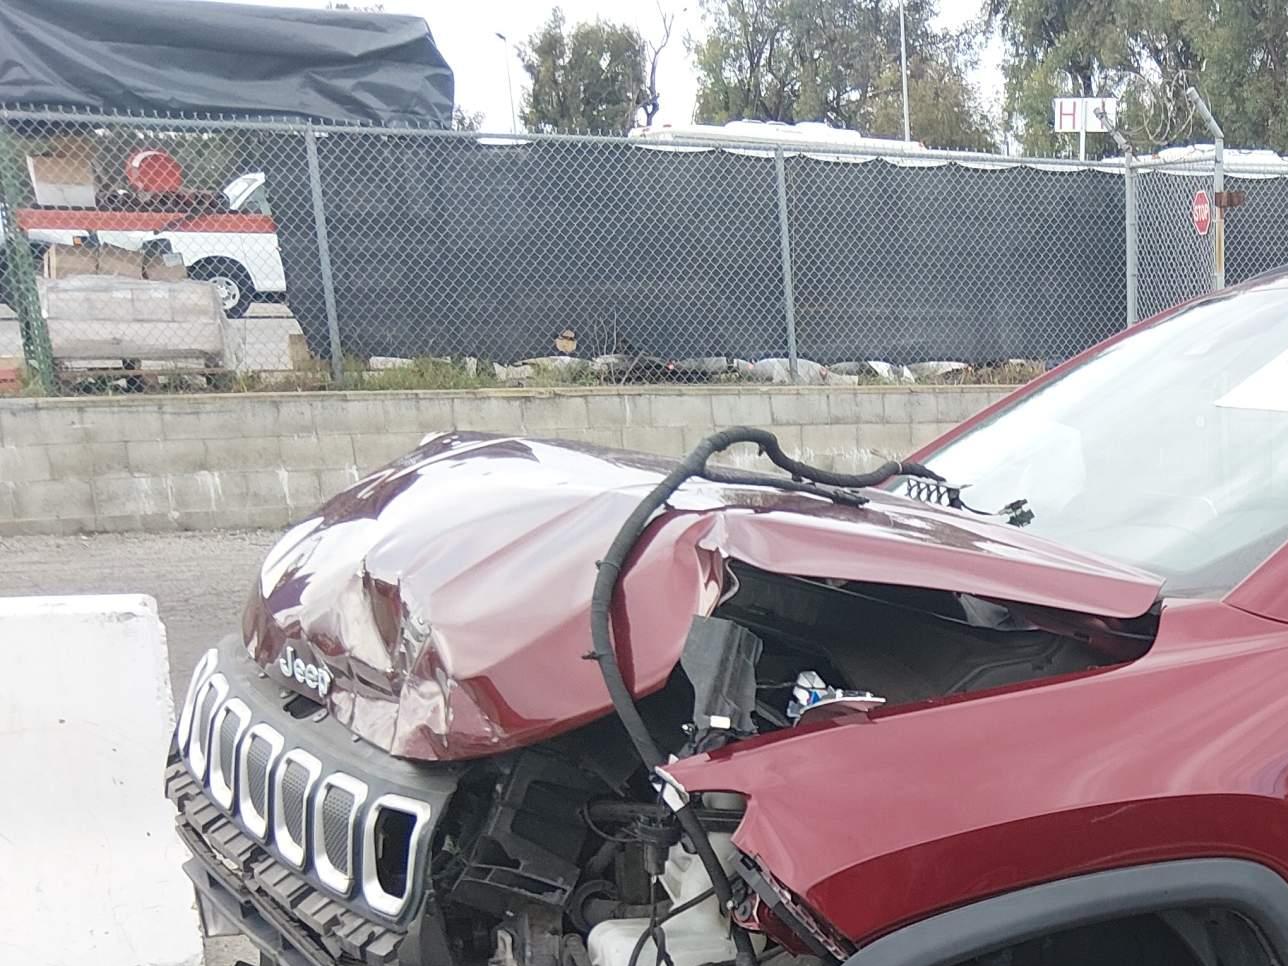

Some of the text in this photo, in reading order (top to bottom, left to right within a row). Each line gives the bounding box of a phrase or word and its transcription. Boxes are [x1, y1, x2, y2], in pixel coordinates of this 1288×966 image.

[1059, 100, 1076, 130] H
[1193, 204, 1210, 222] STOP
[279, 646, 332, 698] Jeep
